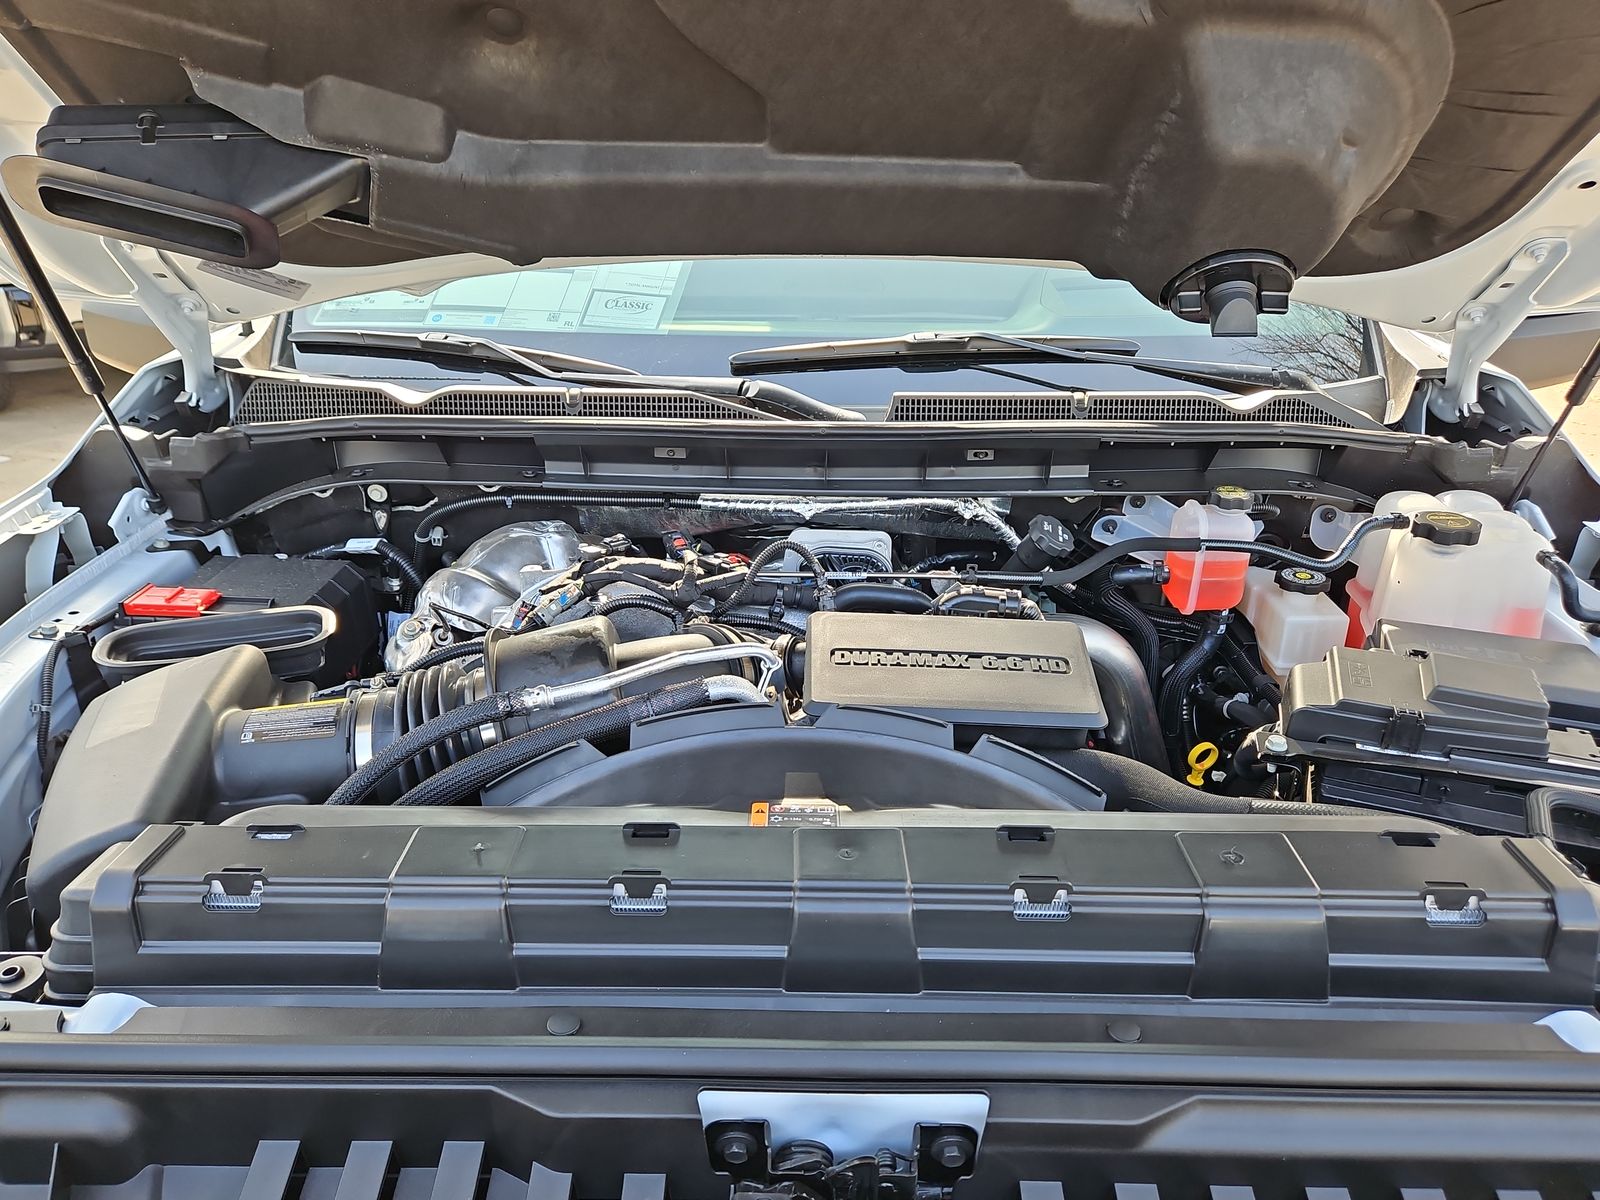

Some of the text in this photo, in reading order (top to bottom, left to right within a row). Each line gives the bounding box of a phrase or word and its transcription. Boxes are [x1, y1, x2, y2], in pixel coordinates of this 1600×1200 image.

[604, 298, 653, 311] CLASSIC
[834, 650, 1067, 673] DURAMAX 6.6 HD
